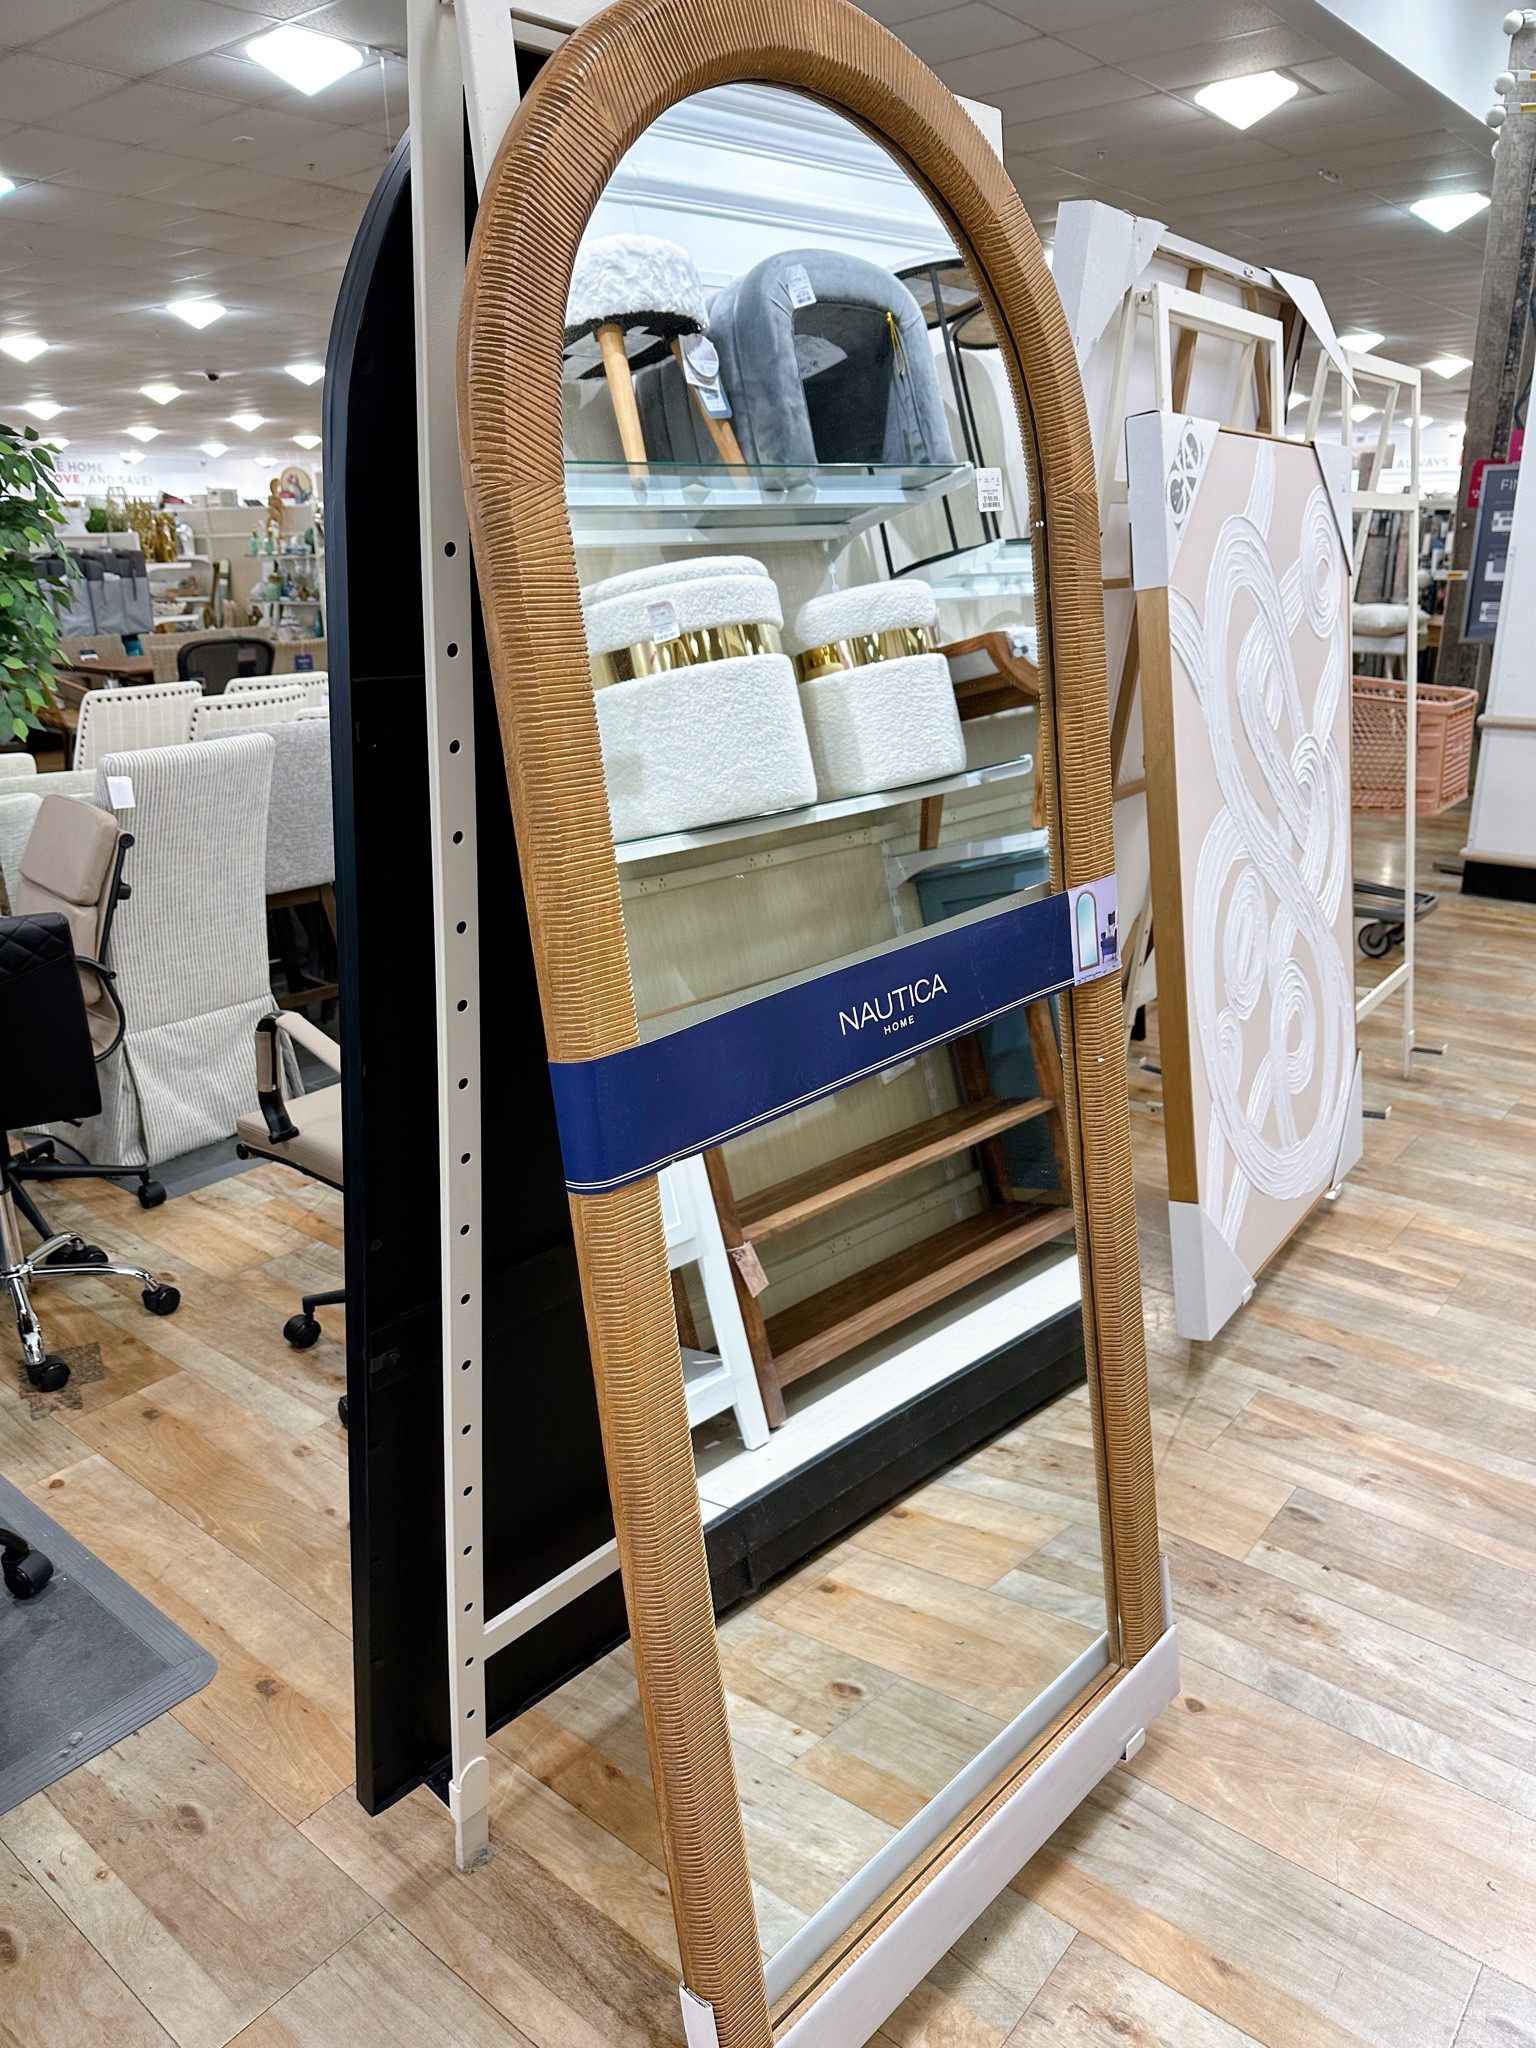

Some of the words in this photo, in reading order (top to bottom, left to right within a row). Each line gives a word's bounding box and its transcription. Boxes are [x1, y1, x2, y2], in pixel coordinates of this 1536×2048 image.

[68, 462, 104, 472] HOME
[89, 475, 115, 485] AND
[119, 475, 153, 486] SAVE!
[838, 973, 948, 1036] NAUTICA
[883, 1014, 915, 1035] HOME
